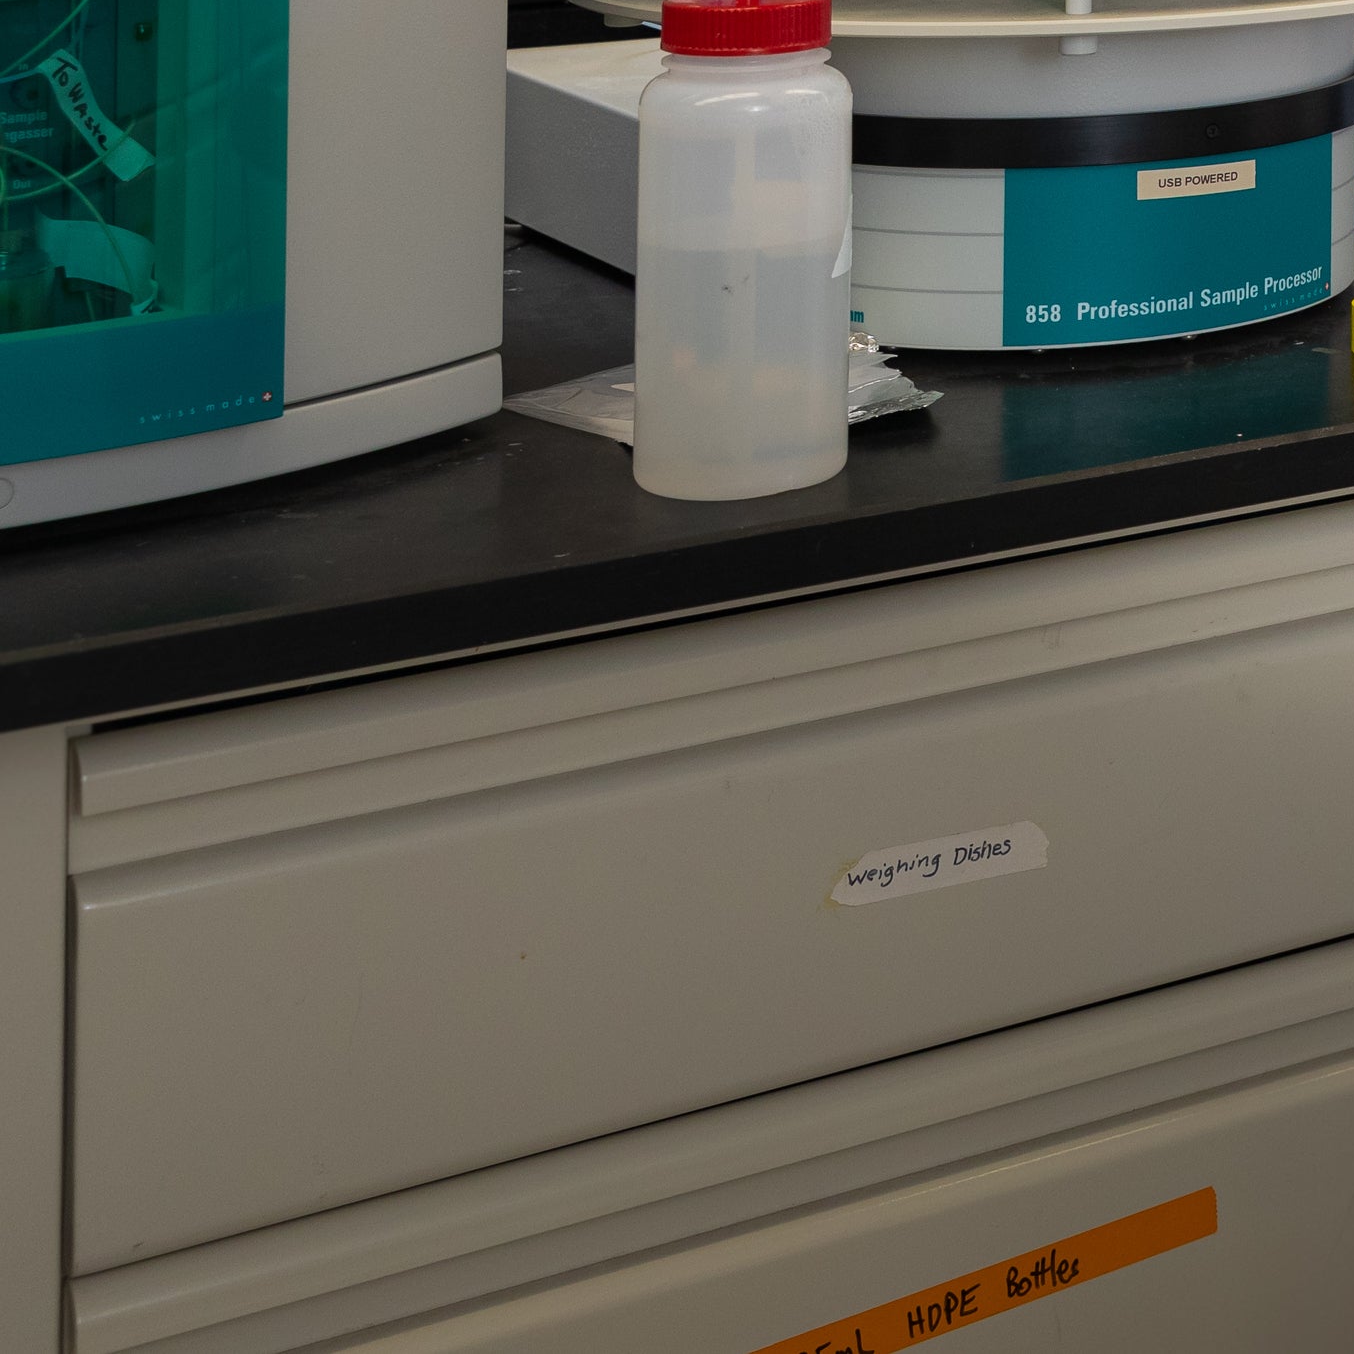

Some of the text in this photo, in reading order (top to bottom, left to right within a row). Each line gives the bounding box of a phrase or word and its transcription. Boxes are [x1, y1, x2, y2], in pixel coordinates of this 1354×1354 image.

[1158, 171, 1239, 189] USB POWERED
[1025, 266, 1323, 324] 858 Professional Sample Processor
[139, 395, 256, 425] swiss made
[953, 839, 1012, 866] Dishes
[906, 1282, 981, 1339] HDPE
[1006, 1248, 1080, 1299] Bottles
